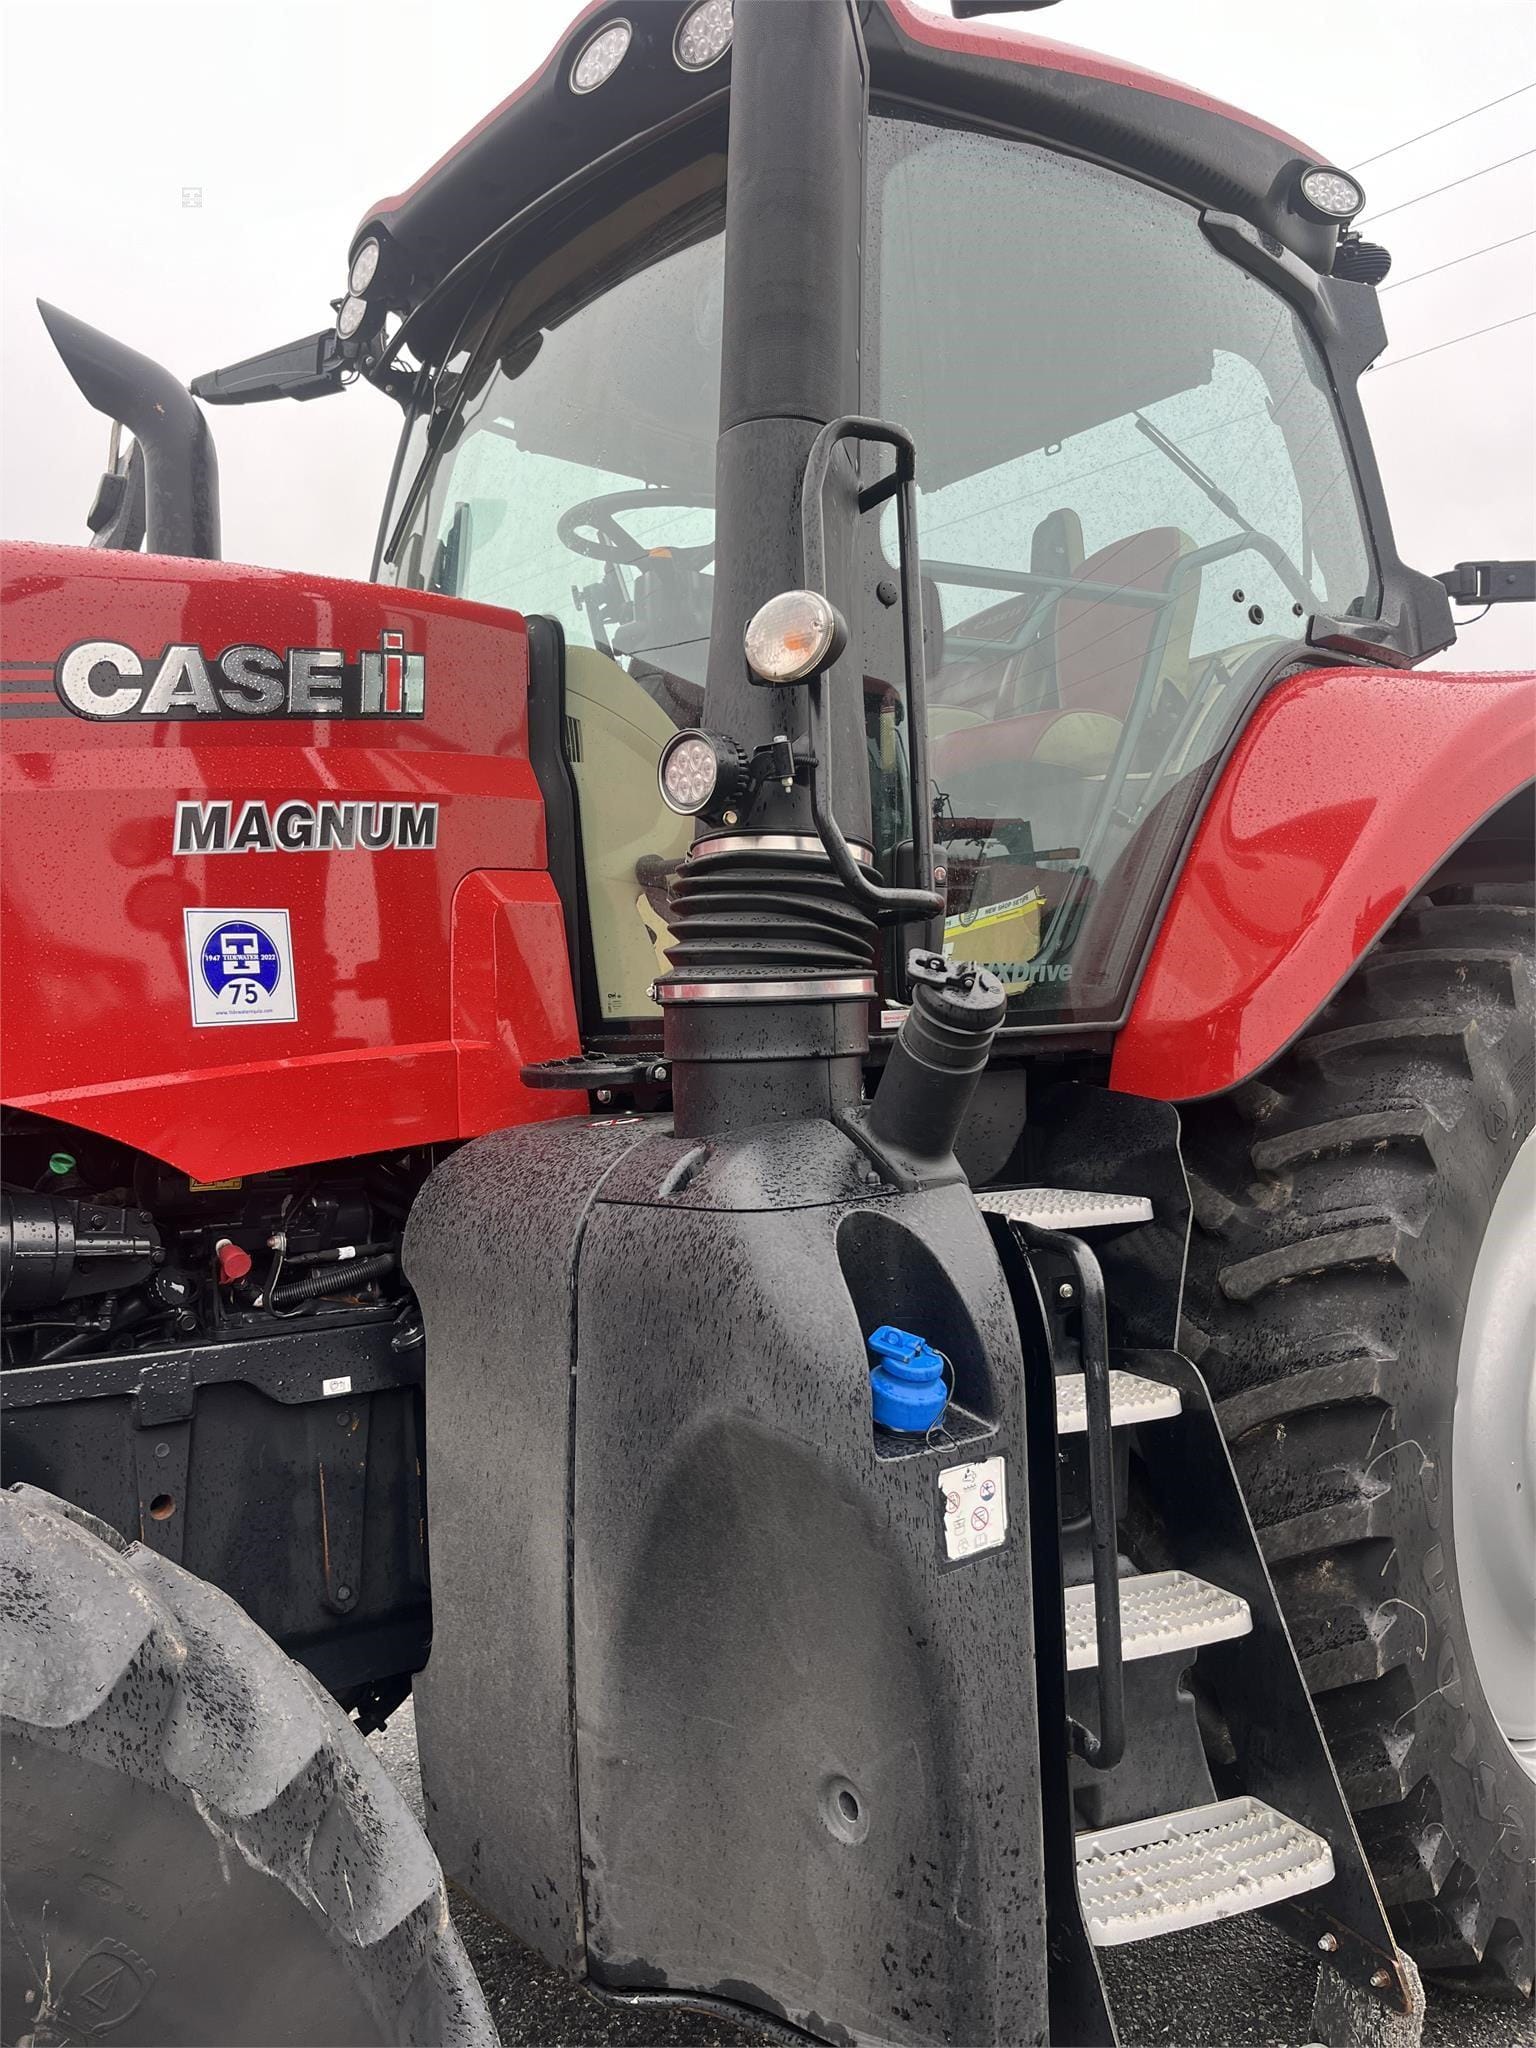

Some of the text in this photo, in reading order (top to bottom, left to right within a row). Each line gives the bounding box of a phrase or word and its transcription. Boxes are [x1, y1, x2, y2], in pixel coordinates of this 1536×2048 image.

[60, 641, 344, 716] CASE
[172, 799, 440, 855] MAGNUM
[228, 983, 258, 1005] 75
